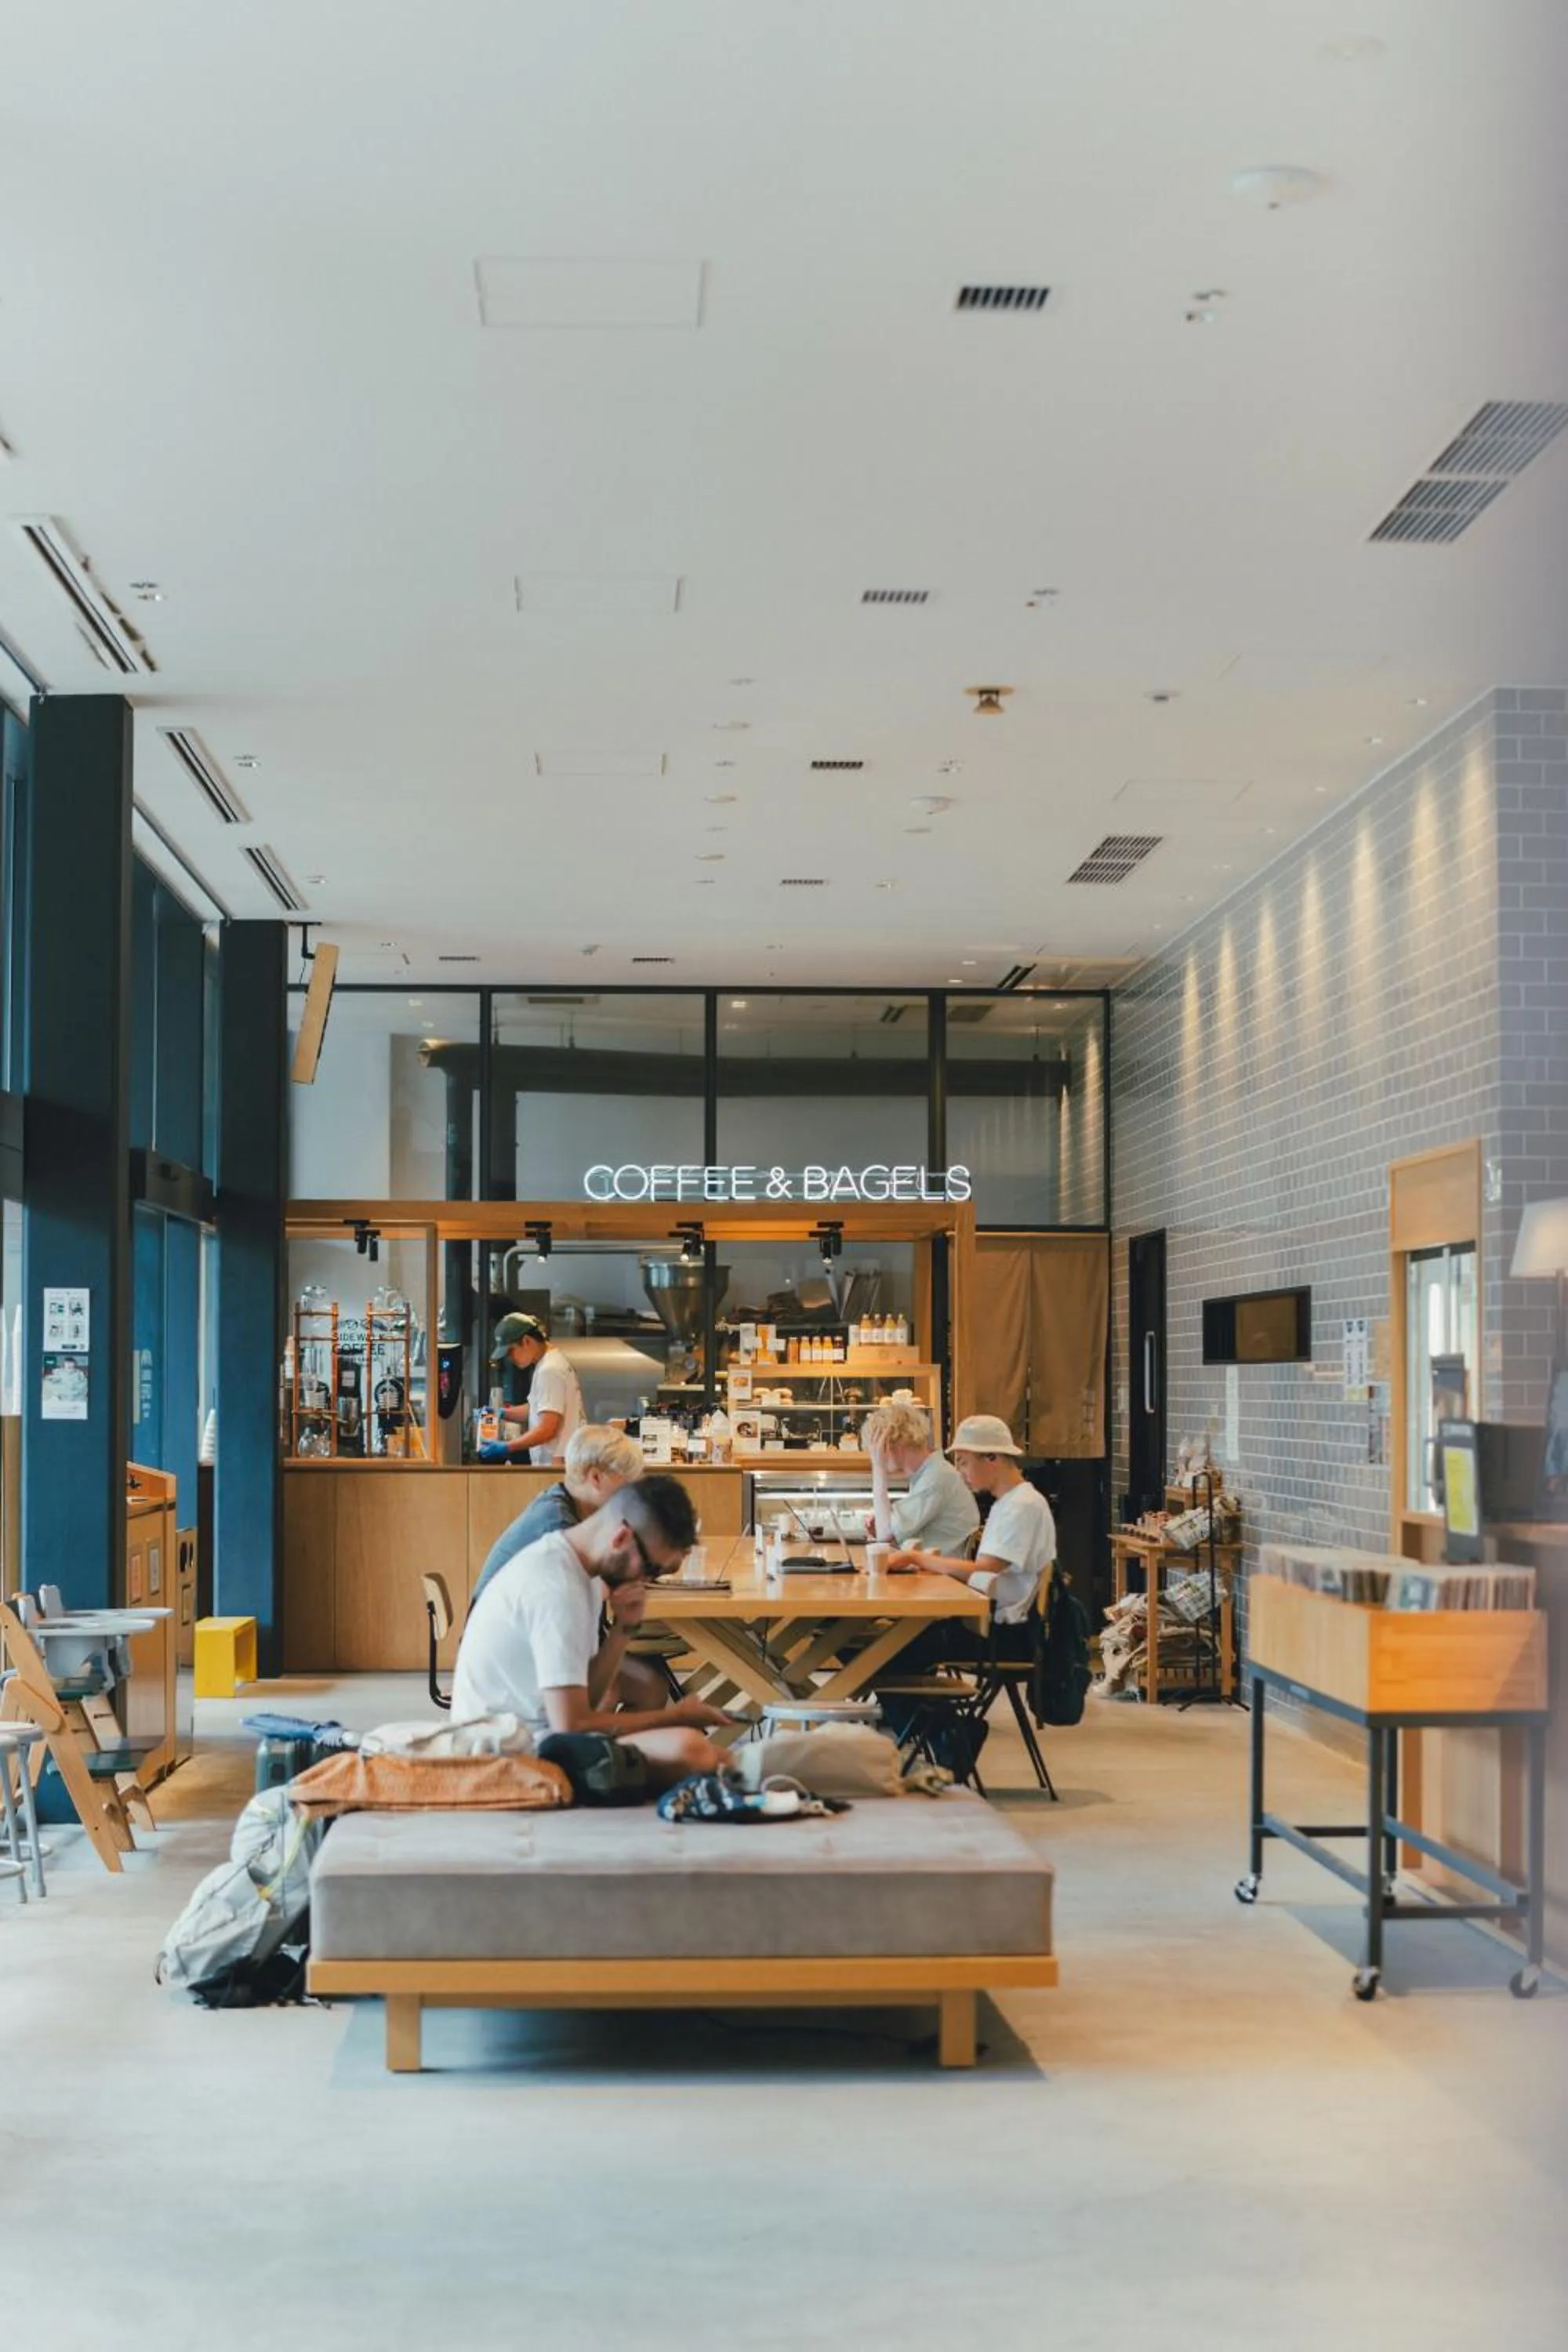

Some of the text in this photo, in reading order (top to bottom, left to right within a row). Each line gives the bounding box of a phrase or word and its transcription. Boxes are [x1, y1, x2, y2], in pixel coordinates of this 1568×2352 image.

[583, 1164, 971, 1202] COFFEE & BAGELS
[332, 1343, 386, 1356] COFFEE
